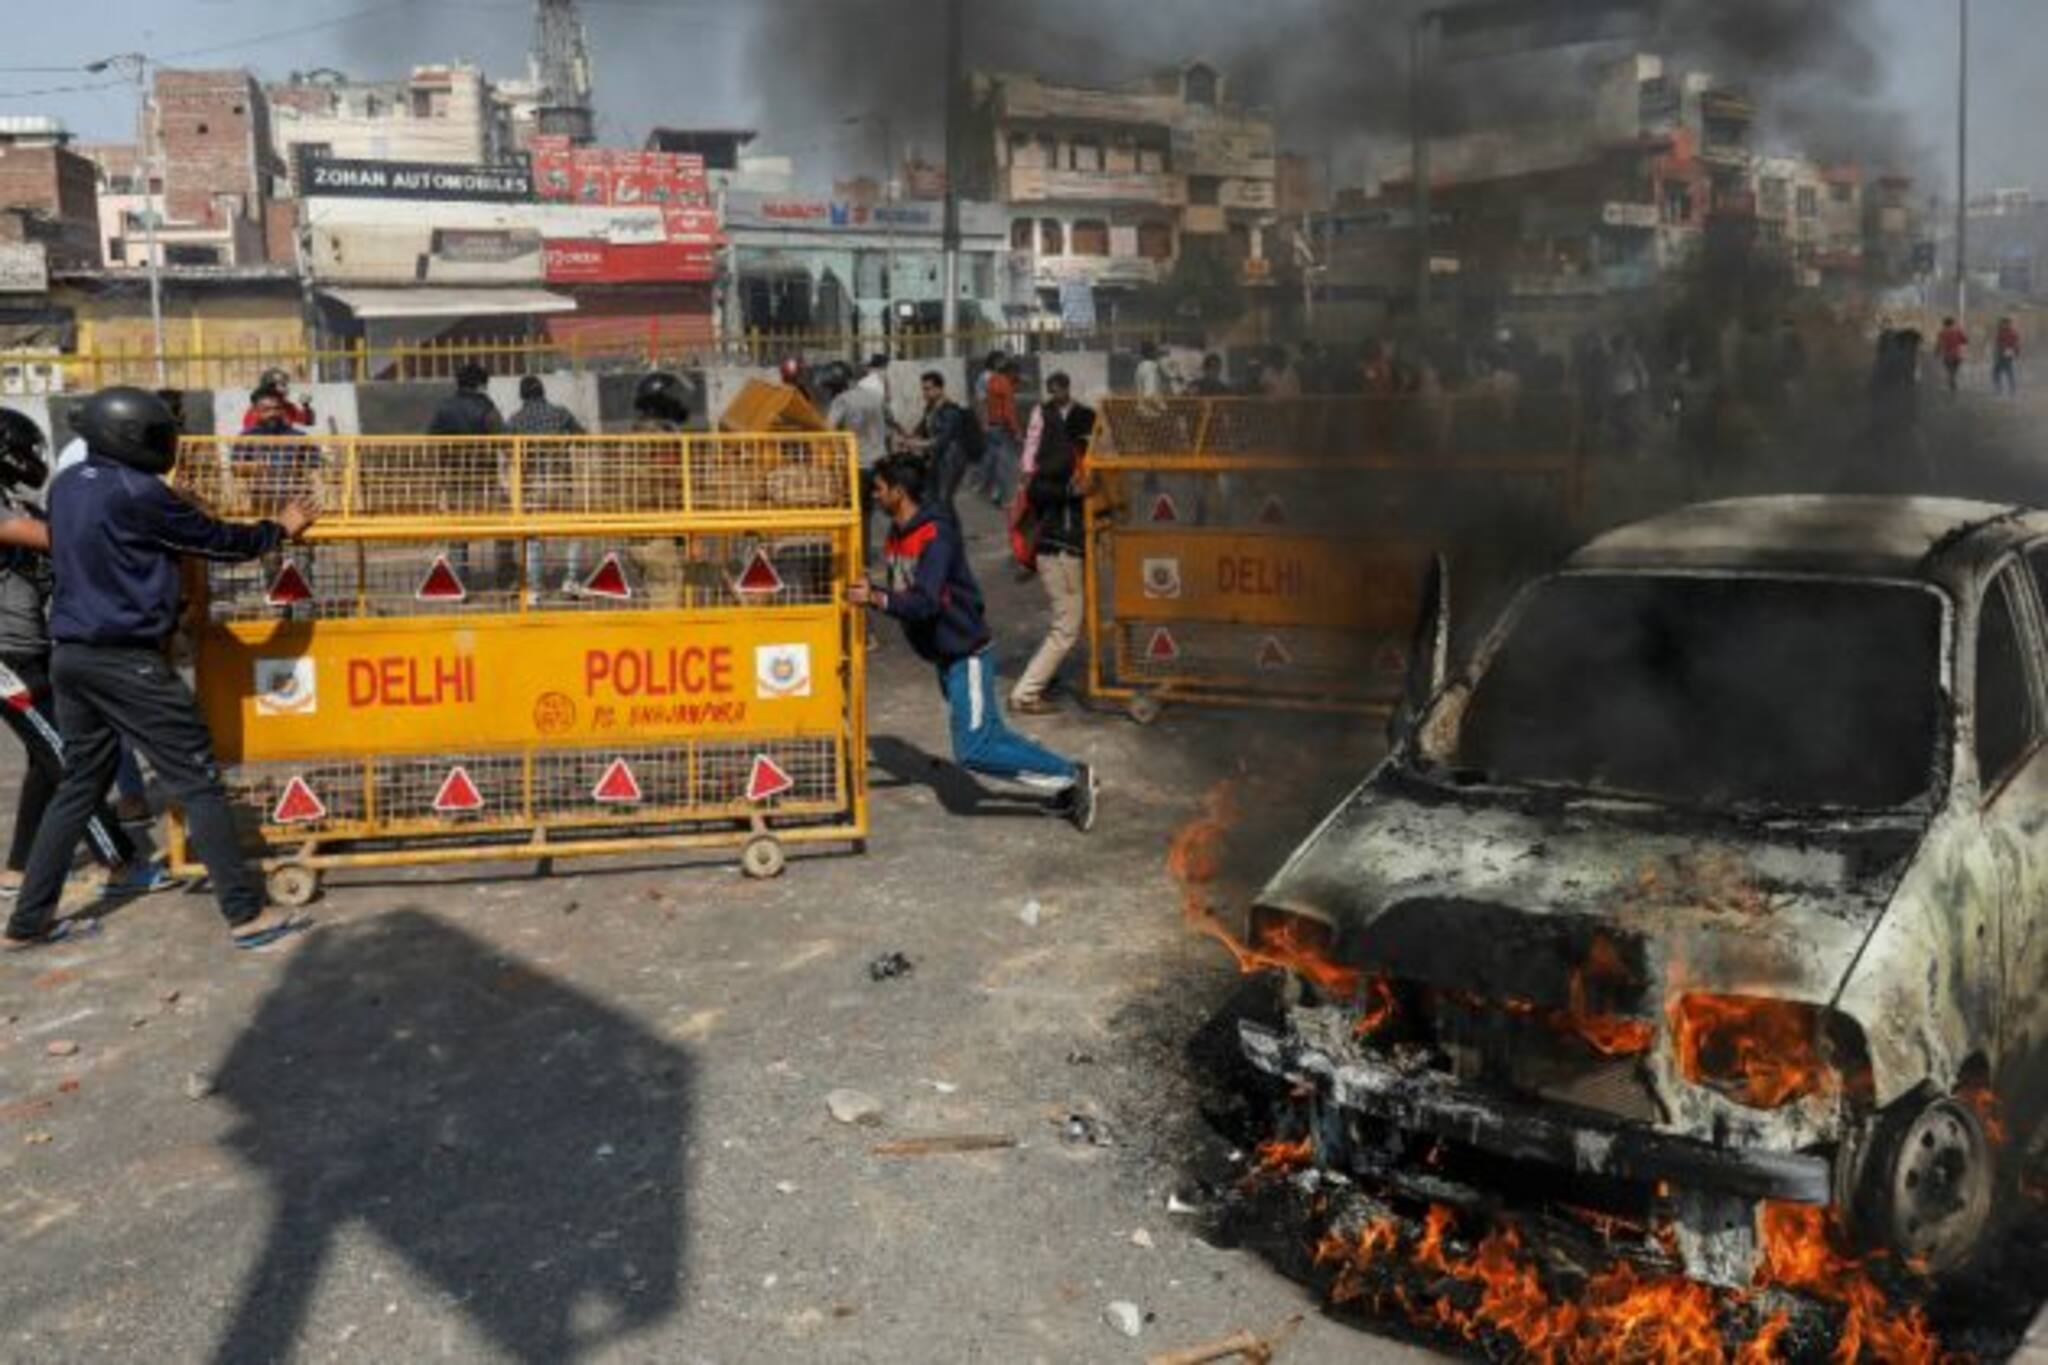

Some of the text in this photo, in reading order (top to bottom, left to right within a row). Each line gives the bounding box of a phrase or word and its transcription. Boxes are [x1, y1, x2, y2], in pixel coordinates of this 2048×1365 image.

[313, 167, 528, 193] ZOHAN AUTOMOBILES
[1217, 556, 1301, 597] DELHI
[347, 647, 732, 707] DELHI POLICE
